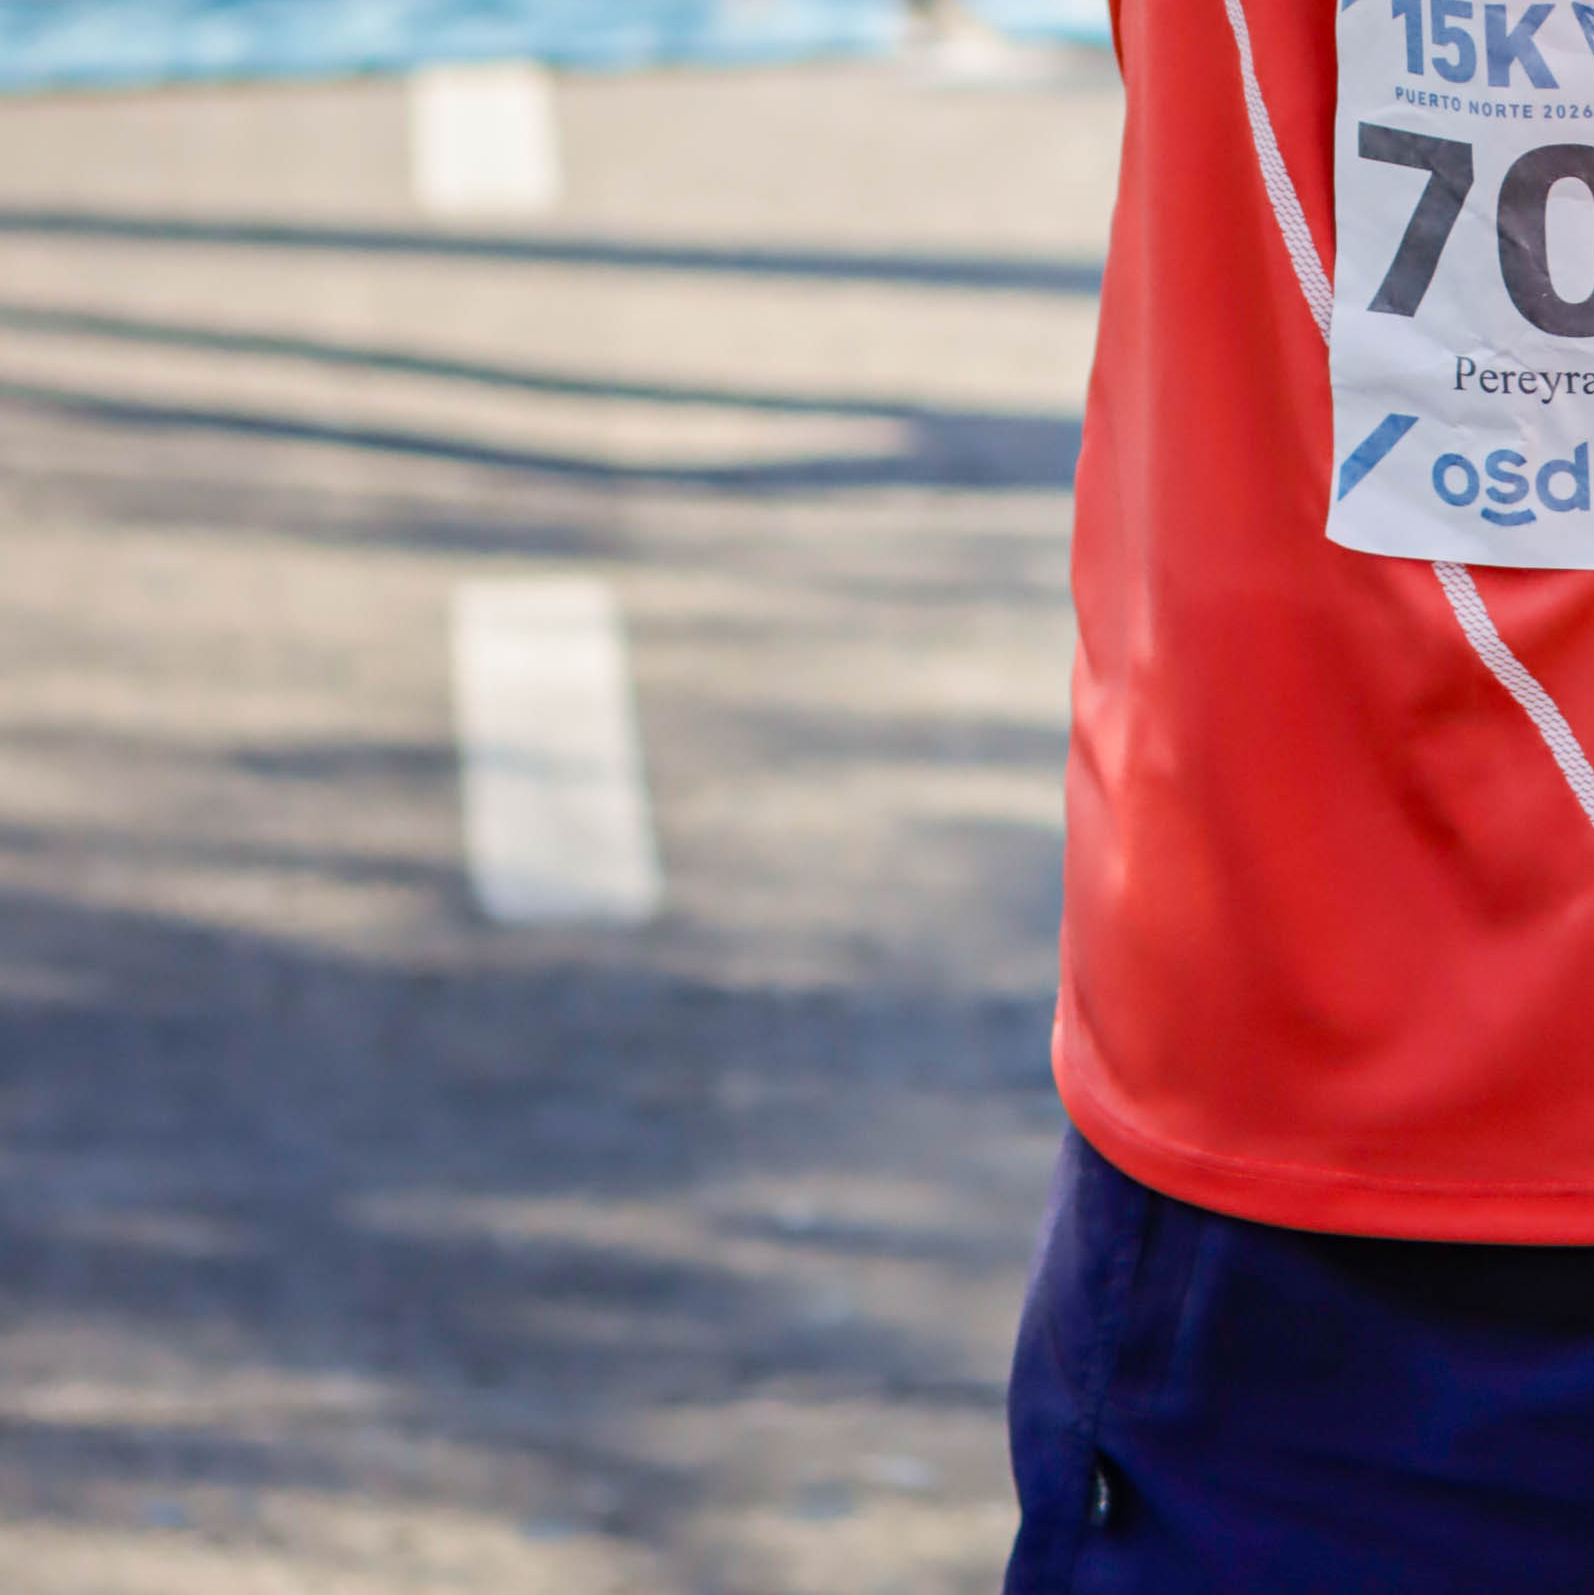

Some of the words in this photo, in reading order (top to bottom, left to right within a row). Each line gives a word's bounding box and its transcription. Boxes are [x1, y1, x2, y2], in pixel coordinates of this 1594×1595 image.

[1395, 86, 1462, 112] PUERTO
[1468, 100, 1534, 119] NORTE
[1543, 104, 1594, 120] 2026
